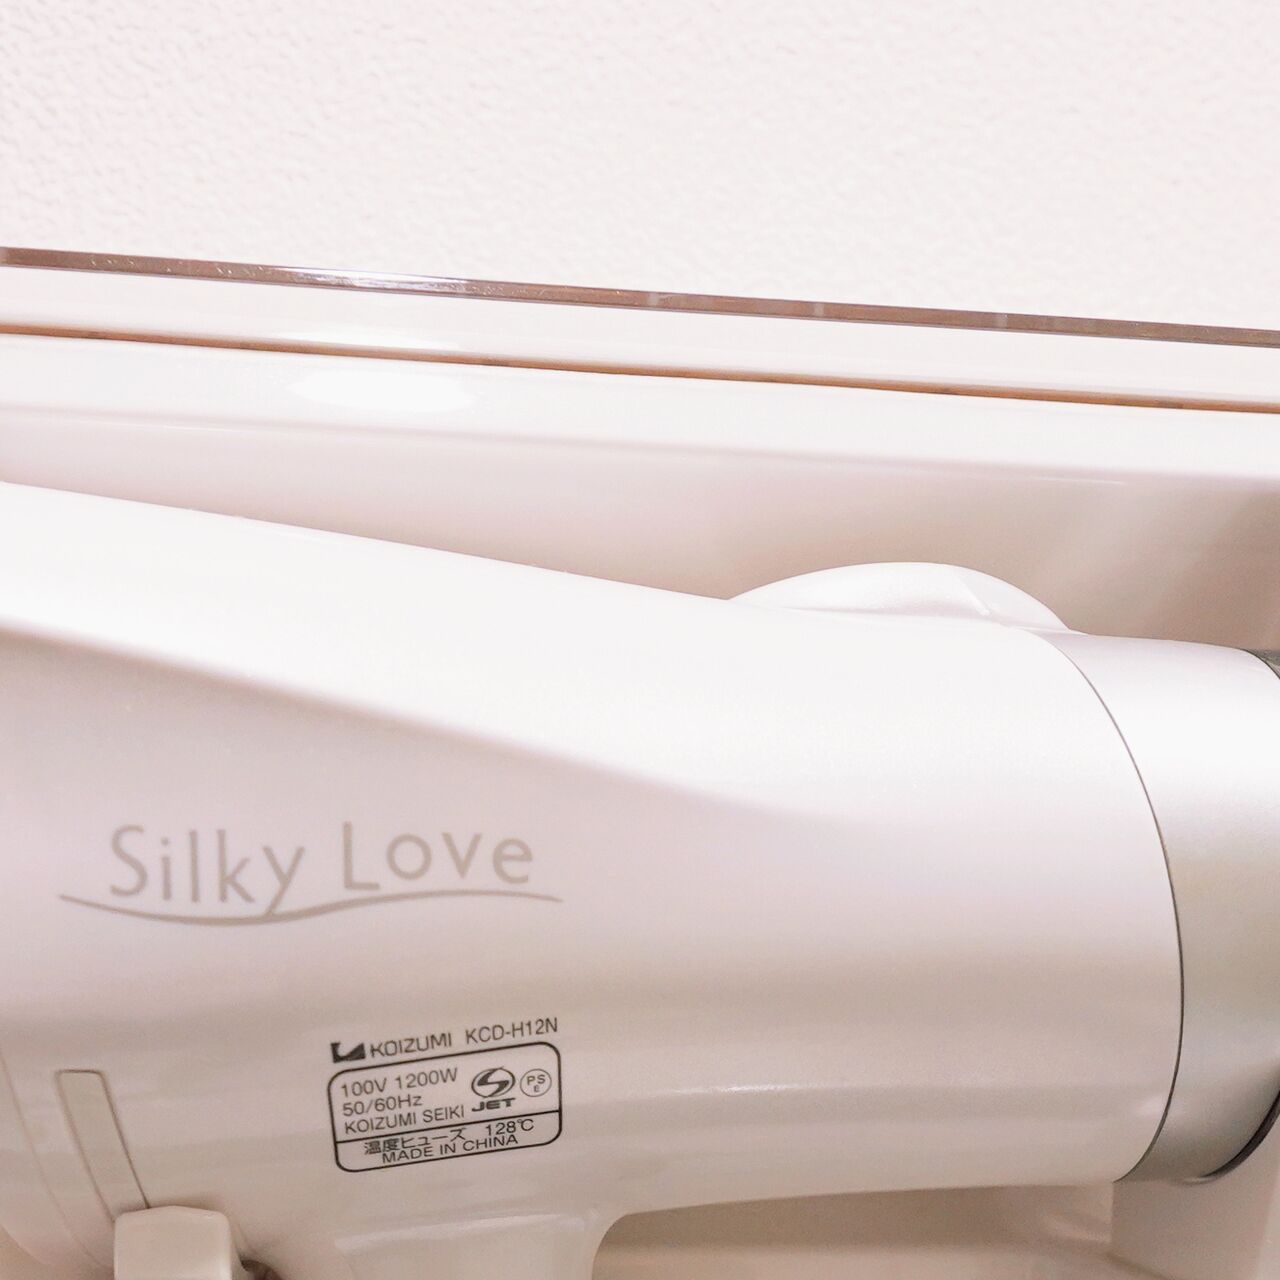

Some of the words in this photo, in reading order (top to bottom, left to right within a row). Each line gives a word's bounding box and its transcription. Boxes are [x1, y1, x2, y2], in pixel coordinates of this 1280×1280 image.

[110, 824, 305, 917] Silky
[342, 821, 534, 892] Love
[370, 1033, 452, 1058] KOIZUMI
[465, 1017, 558, 1045] KCD-H12N
[341, 1077, 387, 1098] 100V
[396, 1067, 458, 1090] 1200W
[342, 1095, 422, 1117] 50/60Hz
[345, 1112, 417, 1135] KOIZUMI
[423, 1105, 464, 1123] SEIKI
[472, 1098, 516, 1112] JET
[364, 1127, 467, 1155] 温度ヒューズ
[382, 1146, 434, 1164] MADE
[440, 1141, 456, 1155] IN
[463, 1134, 519, 1152] CHINA
